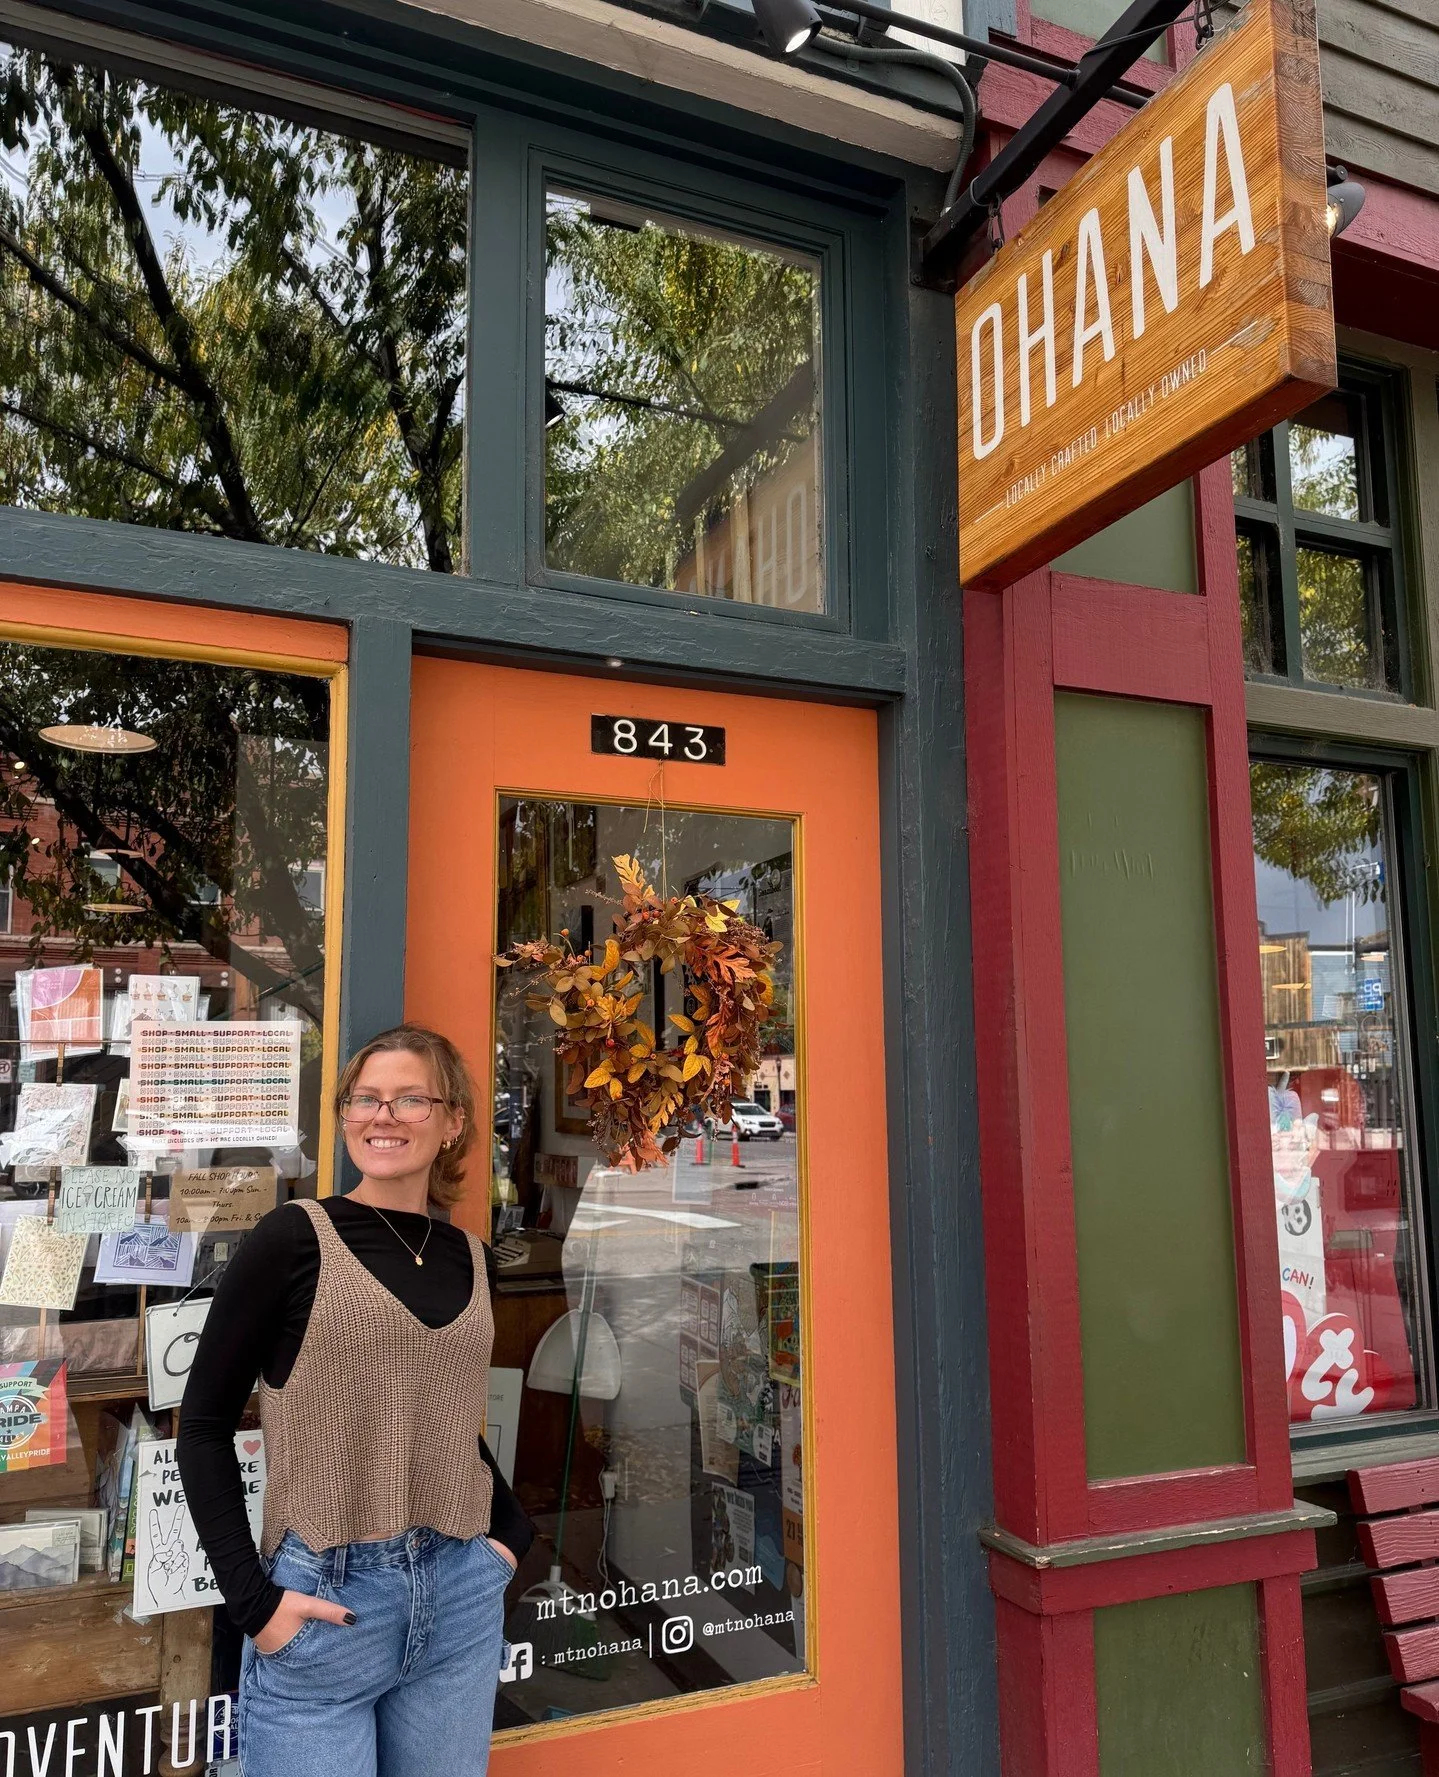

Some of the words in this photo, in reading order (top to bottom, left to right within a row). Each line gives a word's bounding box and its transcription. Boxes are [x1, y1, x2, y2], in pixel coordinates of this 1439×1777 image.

[971, 82, 1255, 461] OHANA
[1006, 461, 1047, 509] LOCALLY
[1051, 426, 1098, 477] CRAFTED
[1105, 384, 1155, 440] LOCALLY
[1161, 349, 1207, 399] OWNED
[613, 719, 707, 760] 843
[142, 1038, 167, 1046] SHOP
[175, 1038, 206, 1046] SMALL
[213, 1038, 255, 1046] SUPPORT
[263, 1038, 290, 1046] LOCAL
[213, 1054, 255, 1062] SUPPORT
[141, 1070, 166, 1078] SHOP
[140, 1088, 166, 1096] SHOP
[173, 1086, 204, 1094] SMALL
[212, 1086, 254, 1094] SUPPORT
[139, 1120, 165, 1128] SHOP
[260, 1118, 288, 1126] LOCAL
[64, 1168, 110, 1184] PLEASE
[116, 1169, 135, 1184] NO
[62, 1186, 82, 1208] ICE
[94, 1186, 137, 1208] CREAM
[61, 1212, 76, 1232] IN
[80, 1212, 124, 1231] STORE
[254, 1212, 263, 1221] Sa
[1282, 1268, 1314, 1290] CAN!
[0, 1404, 26, 1414] AMPA
[0, 1413, 42, 1428] RIDE
[0, 1448, 50, 1460] VALLEYPRIDE
[536, 1564, 763, 1621] mtnohana.com
[703, 1610, 795, 1636] @mtnohana
[554, 1636, 642, 1665] mtnohana
[0, 1694, 232, 1777] VENTUR
